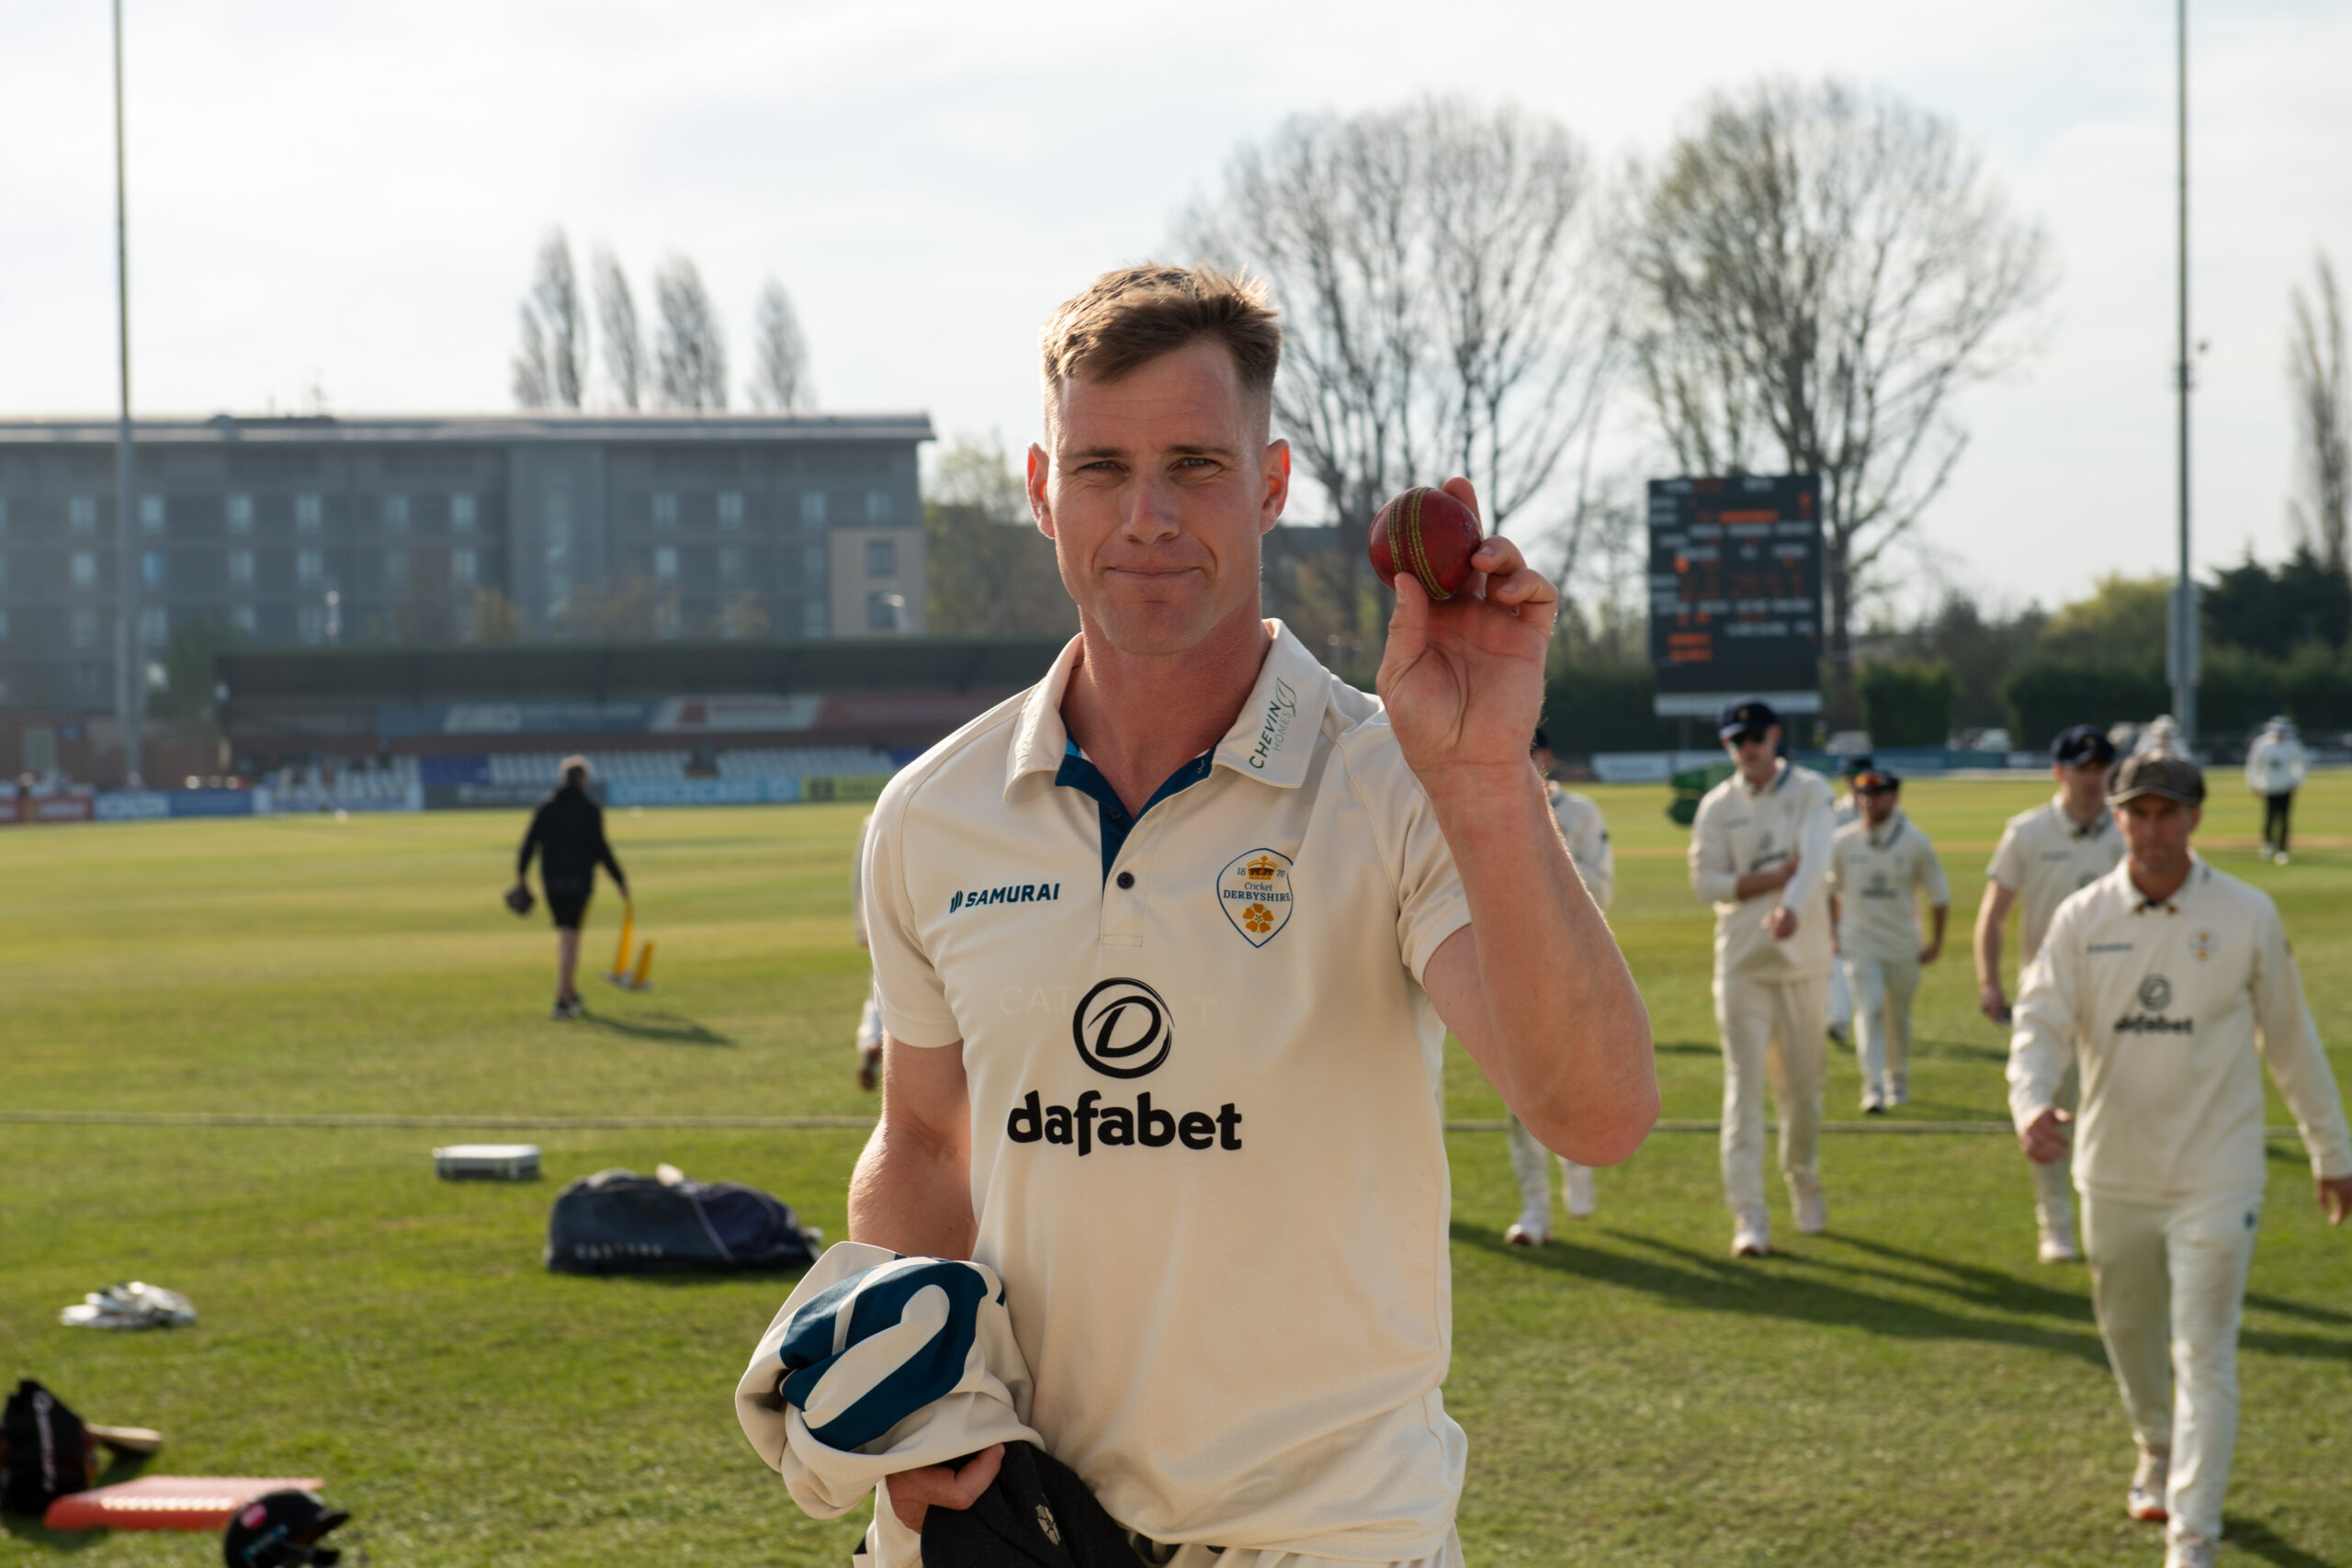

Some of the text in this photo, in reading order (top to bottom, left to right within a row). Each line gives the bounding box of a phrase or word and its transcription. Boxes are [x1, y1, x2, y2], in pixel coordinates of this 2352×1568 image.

[1249, 700, 1282, 769] CHEVIN
[1272, 710, 1292, 751] HOMES
[1237, 866, 1247, 876] 18
[965, 883, 1060, 908] SAMURAI
[1223, 889, 1291, 902] DERBYSHIRE
[1244, 882, 1272, 891] Cricket
[1007, 1089, 1242, 1156] dafabet
